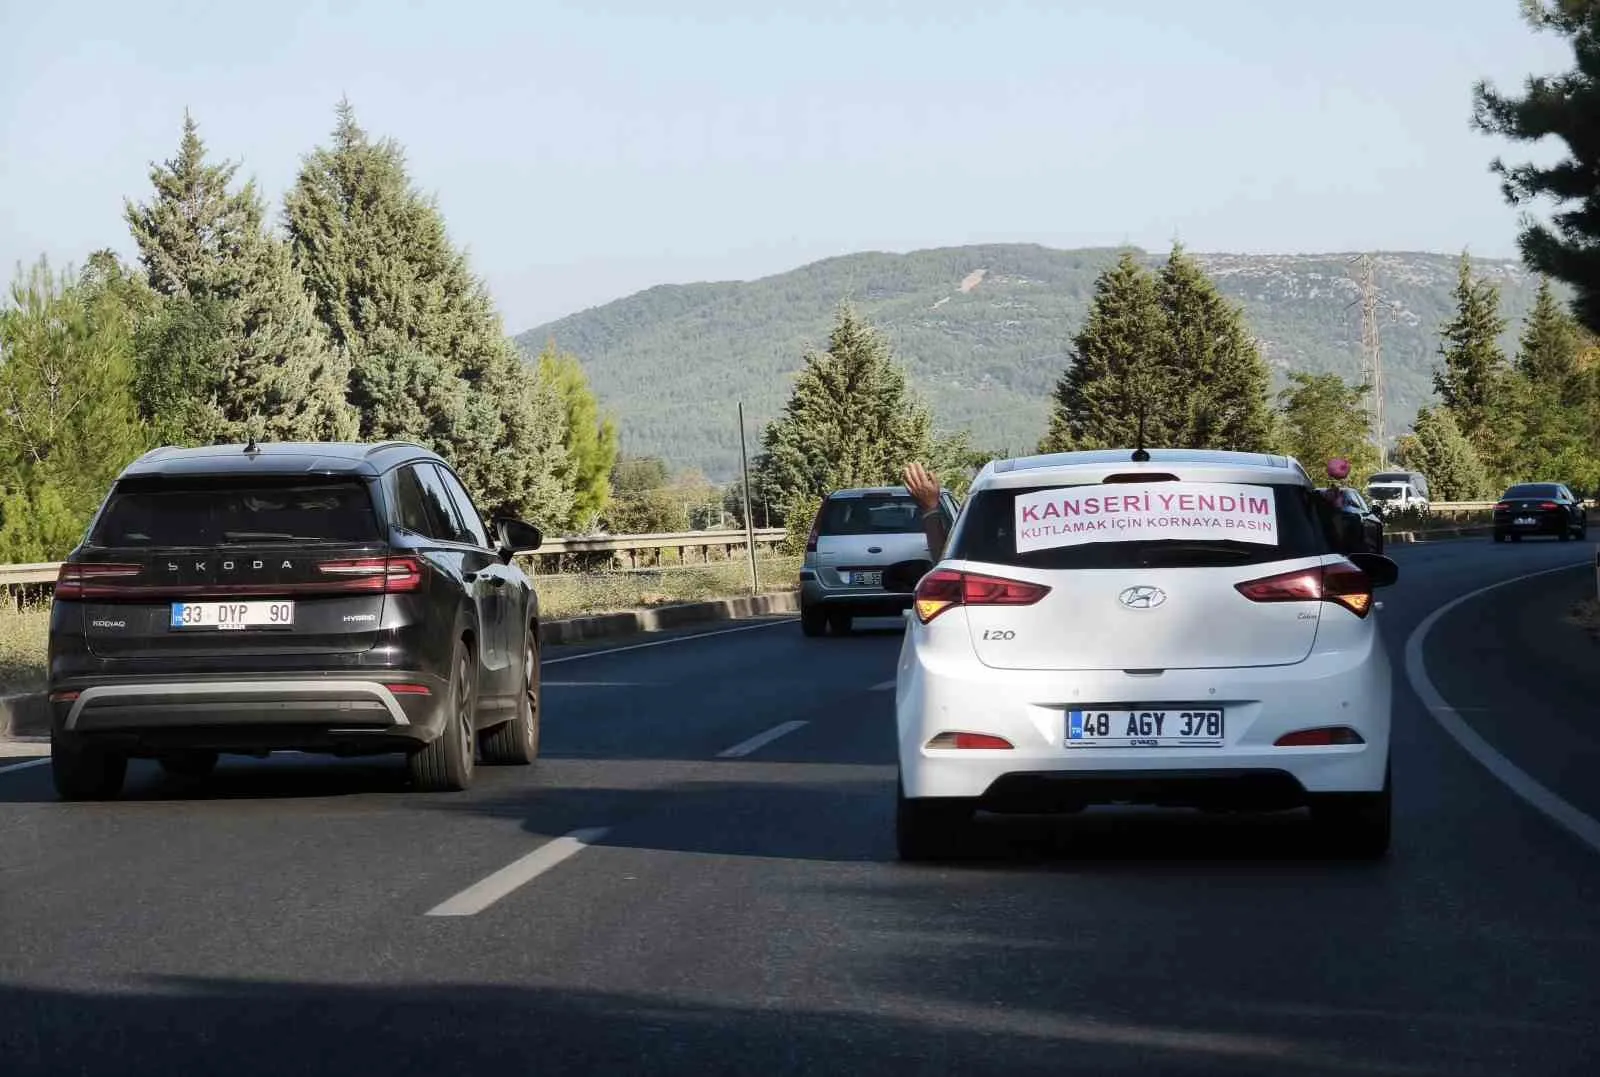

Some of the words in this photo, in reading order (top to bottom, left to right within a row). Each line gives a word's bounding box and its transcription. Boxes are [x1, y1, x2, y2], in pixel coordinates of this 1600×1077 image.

[1022, 490, 1150, 522] KANSERİ
[1158, 492, 1269, 515] YENDİM
[1021, 519, 1107, 539] KUTLAMAK
[1111, 516, 1142, 531] İÇİN
[1147, 517, 1221, 528] KORNAYA
[1225, 519, 1272, 532] BASIN
[183, 606, 203, 623] 33
[218, 605, 248, 622] DYP
[270, 604, 290, 622] 90
[983, 629, 1016, 641] i20
[1083, 712, 1110, 736] 48
[1126, 712, 1166, 736] AGY
[1180, 712, 1220, 736] 378
